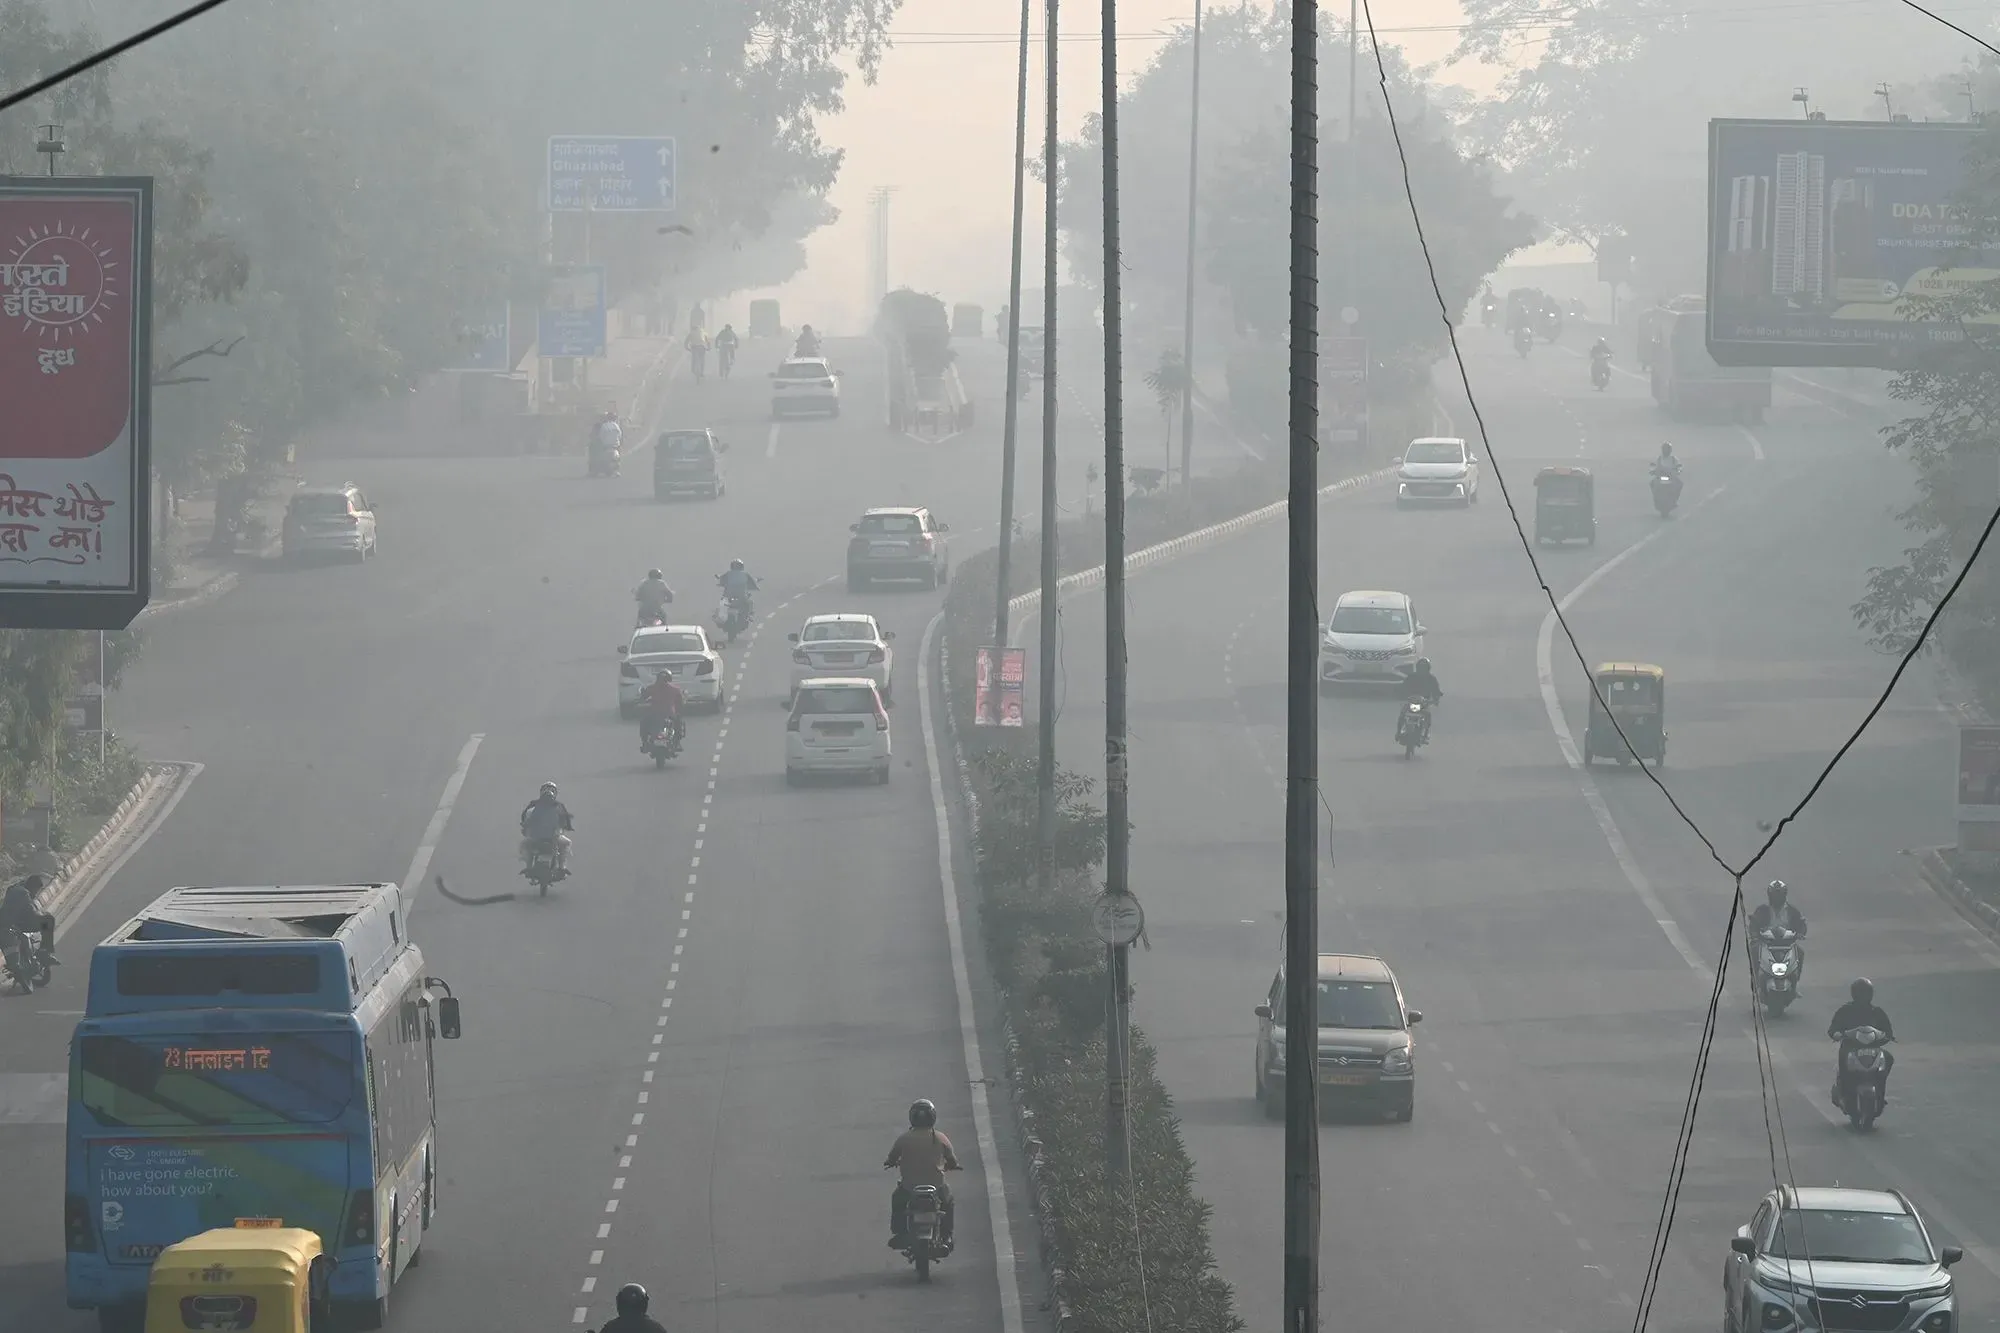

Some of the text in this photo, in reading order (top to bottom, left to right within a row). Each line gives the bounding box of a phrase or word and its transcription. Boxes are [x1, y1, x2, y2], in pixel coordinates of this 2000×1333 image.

[552, 160, 625, 172] Ghaziabad
[602, 194, 638, 206] Vihar
[1891, 203, 1933, 219] DDA
[2, 287, 86, 317] इंडिया
[37, 347, 75, 374] दूध
[108, 1167, 142, 1182] have
[145, 1169, 181, 1183] gone
[183, 1165, 240, 1180] electric.
[101, 1182, 213, 1198] how about you?
